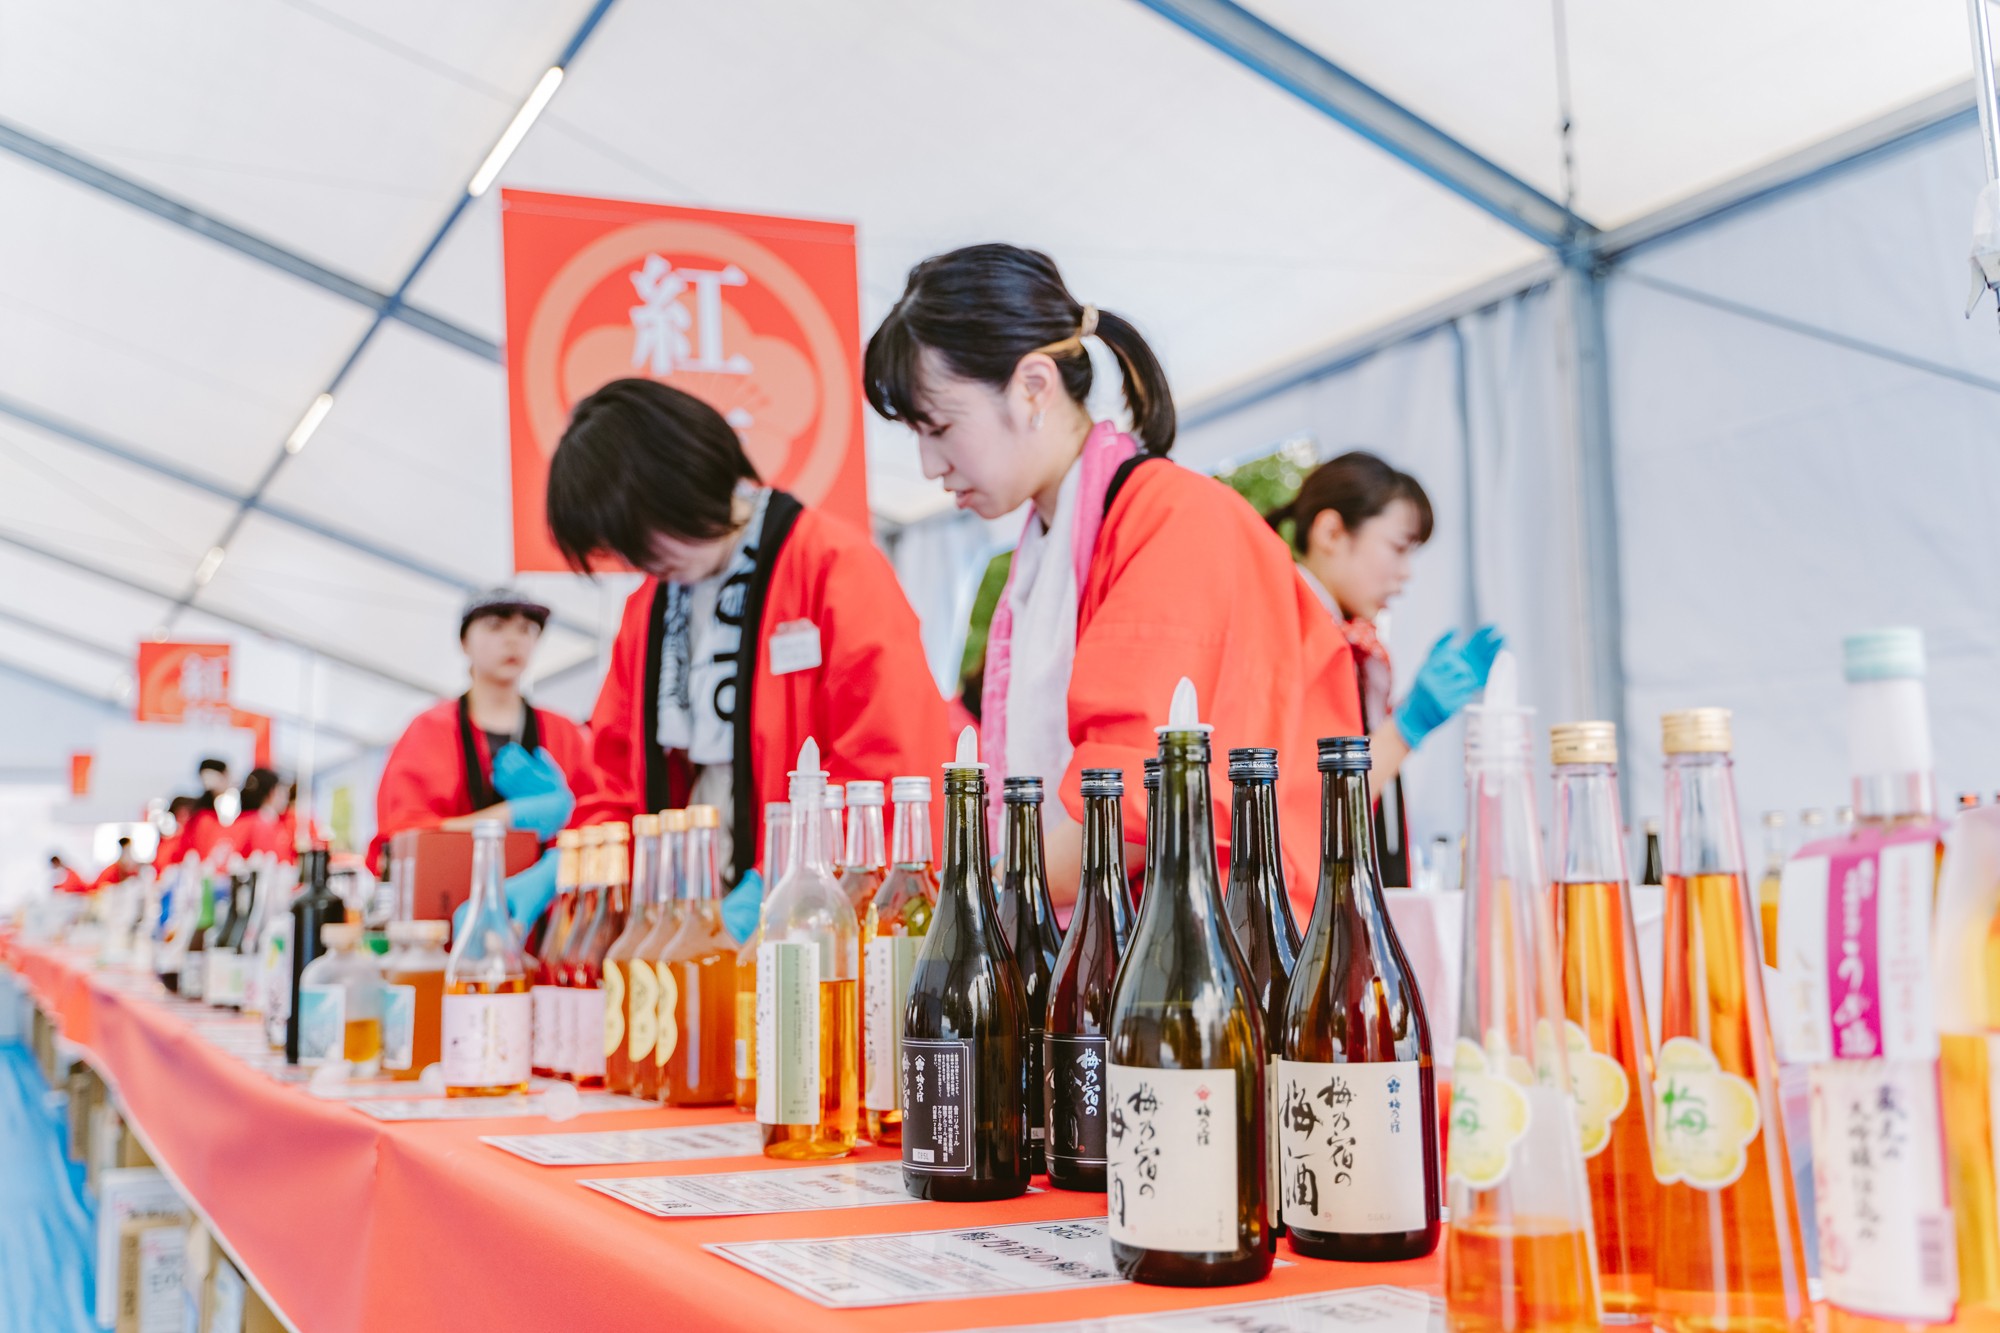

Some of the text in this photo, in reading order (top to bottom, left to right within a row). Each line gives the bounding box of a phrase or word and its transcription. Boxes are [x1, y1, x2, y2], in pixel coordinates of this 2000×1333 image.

[1076, 1048, 1102, 1117] 梅乃宿の
[1195, 1104, 1212, 1147] 梅乃宿
[1388, 1096, 1401, 1135] 梅乃宿
[1127, 1082, 1163, 1199] 梅乃宿の
[1279, 1079, 1324, 1217] 梅酒
[1317, 1075, 1358, 1187] 梅乃宿の
